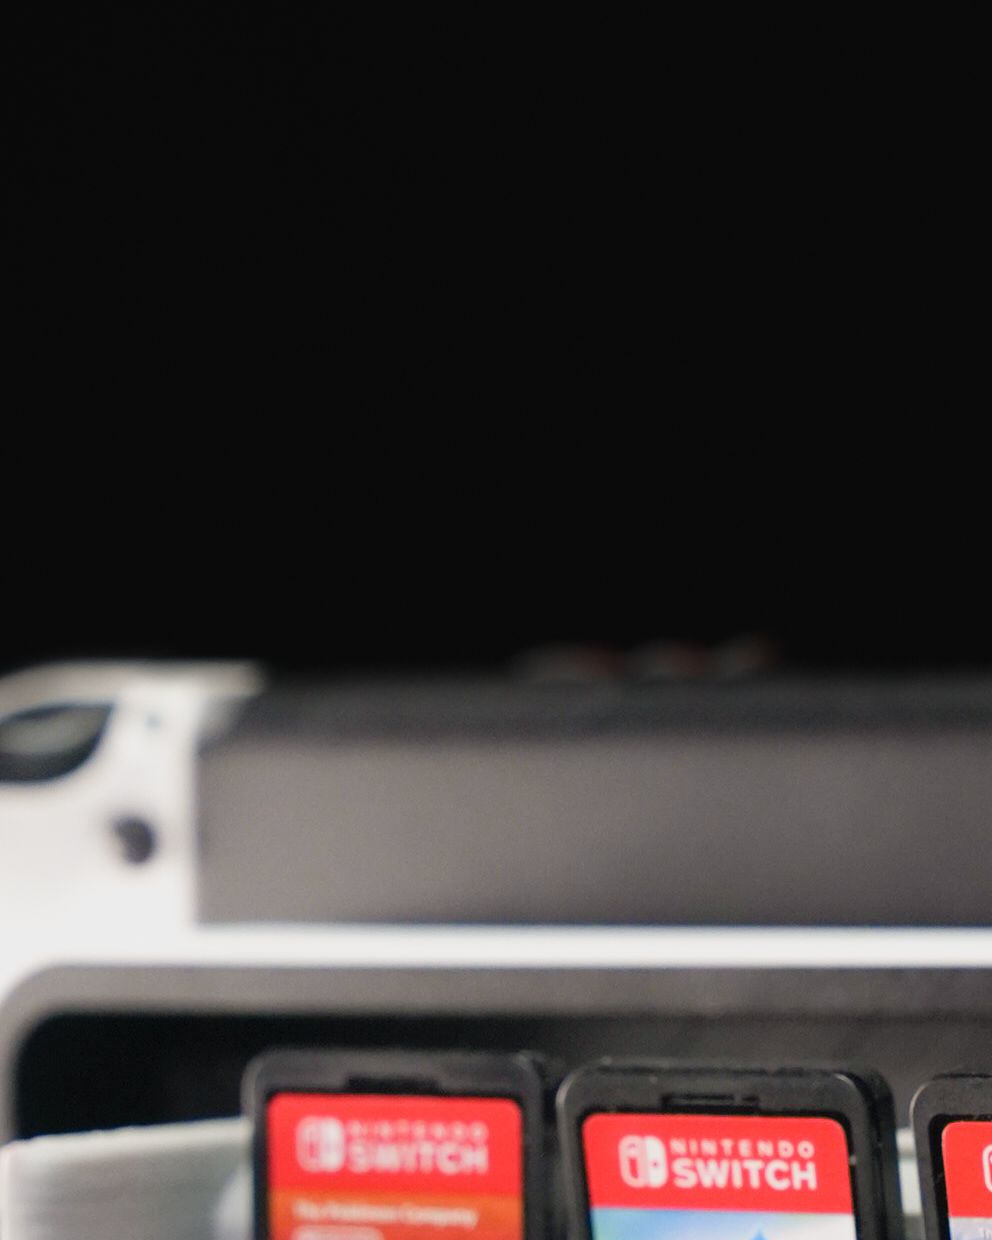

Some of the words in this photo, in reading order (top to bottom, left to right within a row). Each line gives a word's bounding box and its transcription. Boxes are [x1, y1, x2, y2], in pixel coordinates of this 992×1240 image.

[350, 1120, 488, 1142] NINTENDO
[350, 1141, 488, 1175] SWITCH
[670, 1138, 815, 1159] NINTENDO
[672, 1157, 818, 1191] SWITCH
